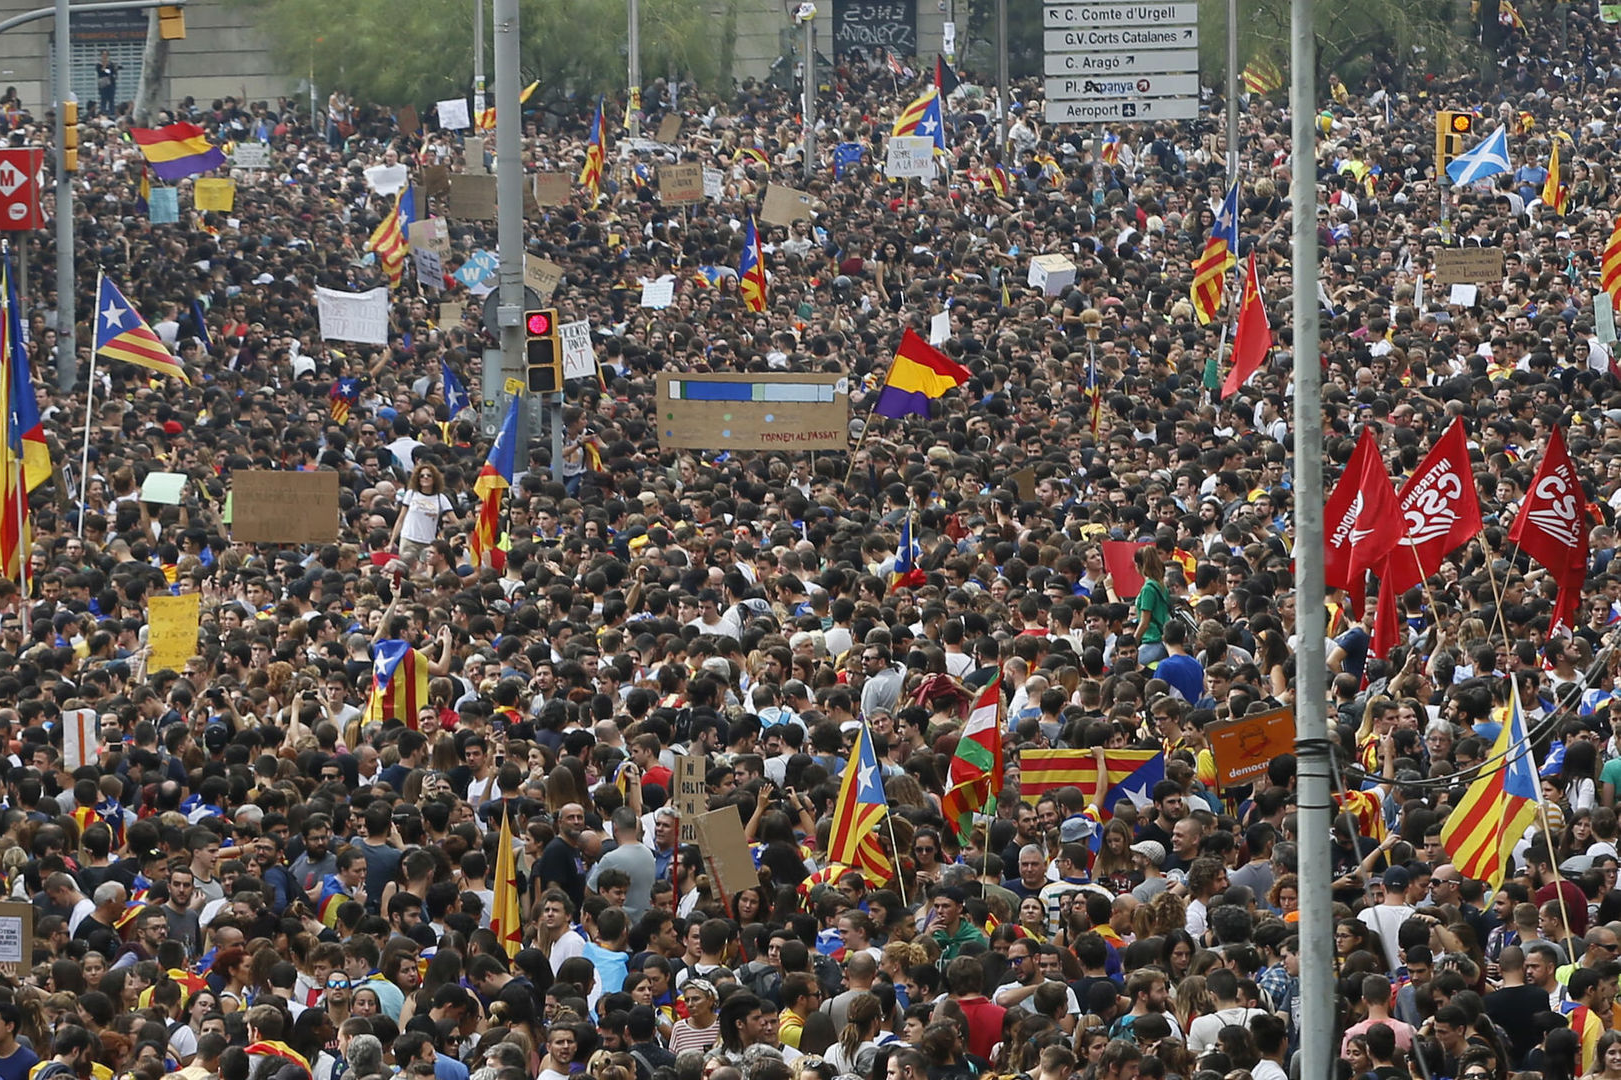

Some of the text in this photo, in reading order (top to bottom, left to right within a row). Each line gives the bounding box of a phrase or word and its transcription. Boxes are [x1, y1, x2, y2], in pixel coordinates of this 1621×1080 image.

[1064, 6, 1175, 22] C. Comte d'Urgell
[1089, 32, 1119, 44] Corts
[1122, 30, 1177, 44] Catalanes
[1065, 55, 1120, 70] C. Aragó
[1067, 104, 1119, 120] Aeroport
[0, 169, 15, 187] M
[808, 430, 840, 443] PASSAT
